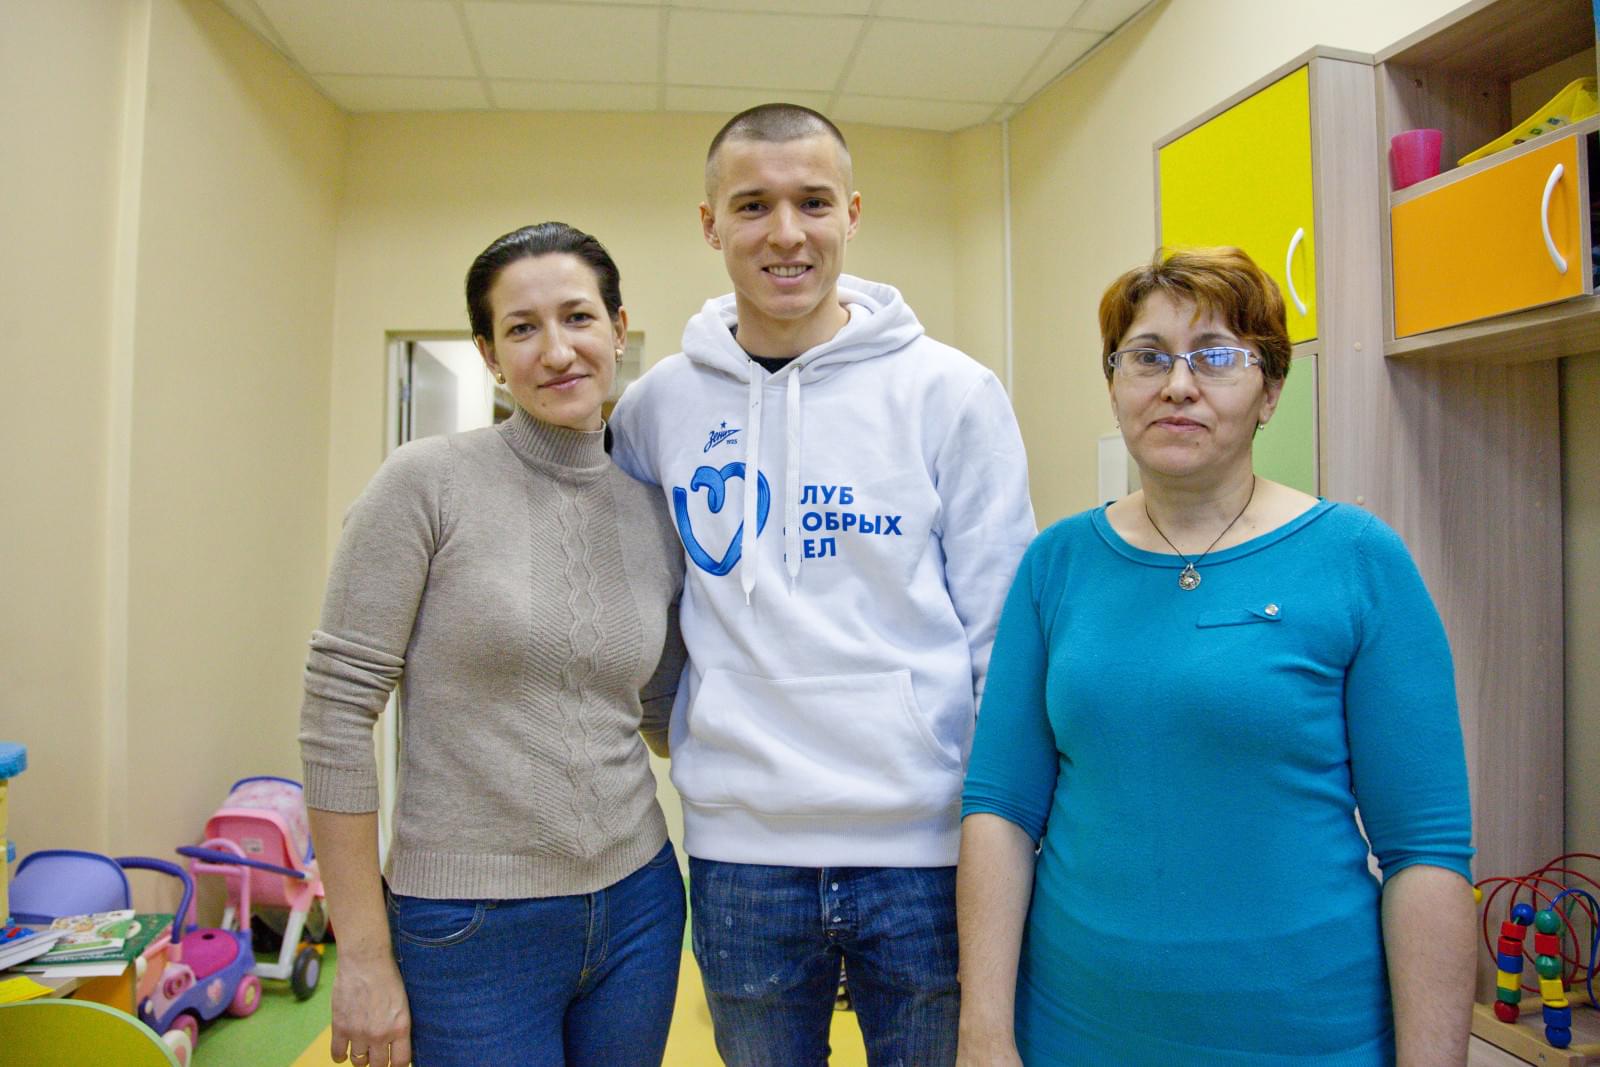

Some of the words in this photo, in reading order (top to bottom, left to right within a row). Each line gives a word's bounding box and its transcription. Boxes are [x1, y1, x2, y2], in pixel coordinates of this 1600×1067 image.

[786, 485, 854, 505] ЛУБ
[784, 512, 903, 536] ОБРЫХ
[784, 537, 837, 563] ЕЛ
